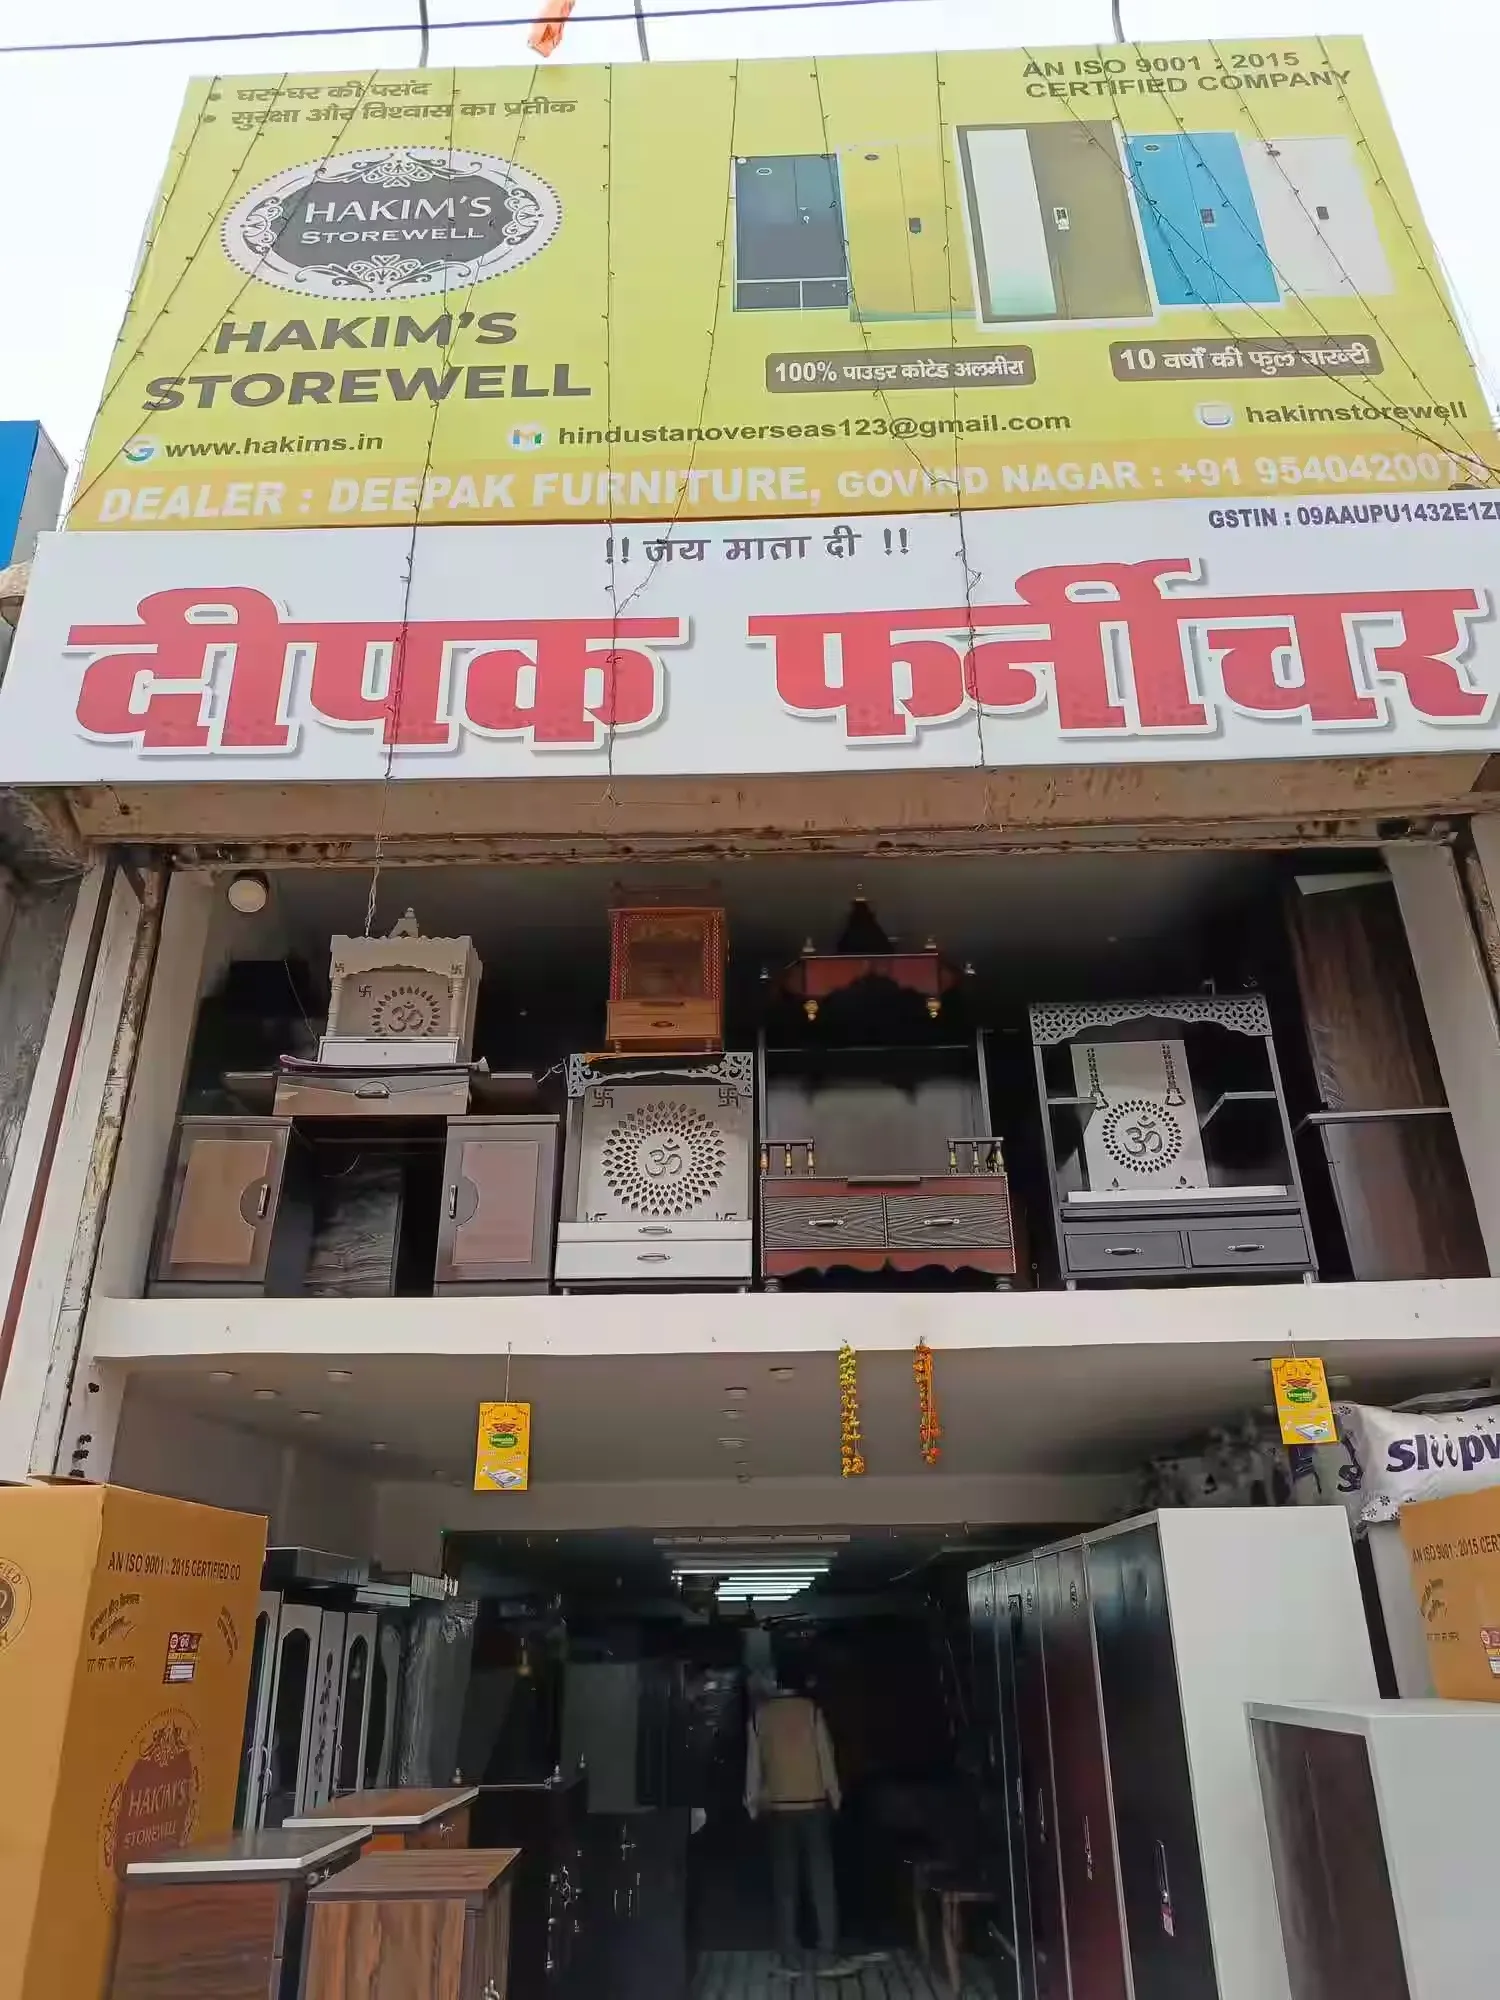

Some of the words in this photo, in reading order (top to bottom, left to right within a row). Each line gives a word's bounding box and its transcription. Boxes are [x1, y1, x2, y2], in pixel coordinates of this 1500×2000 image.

[1022, 61, 1064, 78] AN
[1075, 58, 1126, 76] ISO
[1135, 55, 1200, 73] 9001
[1231, 52, 1300, 70] 2015
[327, 80, 364, 99] की
[1025, 76, 1188, 98] CERTIFIED
[1197, 69, 1351, 92] COMPANY
[231, 108, 301, 131] सुरक्षा
[306, 102, 354, 122] और
[361, 101, 451, 120] विश्वास
[459, 102, 497, 117] का
[503, 95, 579, 117] प्रतीक
[303, 196, 493, 224] HAKIM'S
[300, 227, 486, 245] STOREWELL
[213, 310, 519, 354] HAKIM'S
[775, 360, 838, 382] 100%
[842, 364, 898, 382] पाउडर
[901, 358, 950, 380] कोटेड
[953, 355, 1025, 377] अलमीरा
[1120, 348, 1156, 370] 10
[1209, 345, 1244, 368] की
[1247, 349, 1296, 375] फुल
[142, 363, 592, 412] STOREWELL
[1245, 400, 1469, 424] hakimstorewell
[558, 413, 1072, 445] hindustanoverseas123@gmail.com
[164, 433, 384, 458] www.hakims.in
[98, 480, 287, 523] DEALER
[326, 472, 515, 514] DEEPAK
[531, 466, 822, 508] FURNITURE,
[836, 466, 990, 499] GOVIND
[1001, 460, 1143, 493] NAGAR
[1175, 456, 1242, 488] +91
[1208, 507, 1276, 529] GSTIN
[642, 538, 712, 563] जय
[722, 535, 813, 561] माता
[822, 525, 862, 559] दी
[64, 584, 684, 750] दीपक
[746, 556, 1490, 742] फर्नीचर
[108, 1551, 124, 1573] AN
[125, 1551, 143, 1573] ISO
[144, 1553, 164, 1575] 9001
[191, 1559, 230, 1580] CERTIFIED
